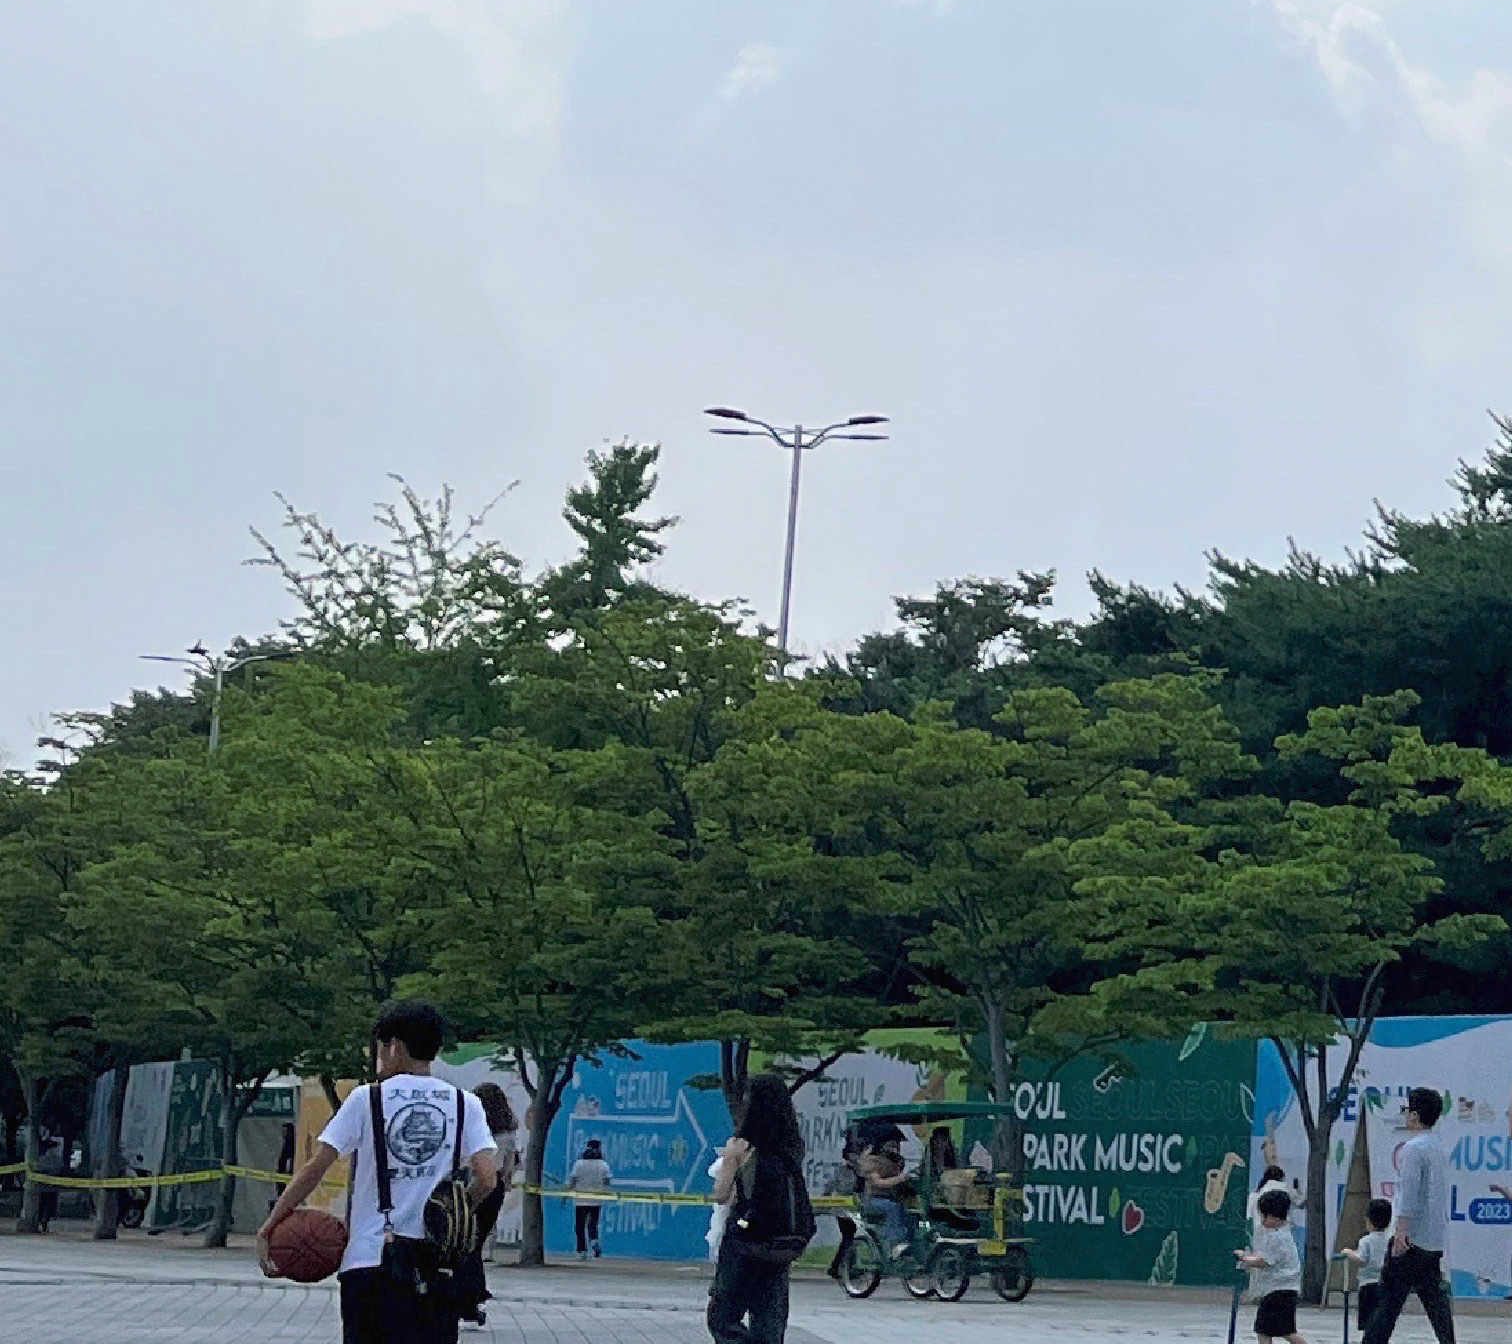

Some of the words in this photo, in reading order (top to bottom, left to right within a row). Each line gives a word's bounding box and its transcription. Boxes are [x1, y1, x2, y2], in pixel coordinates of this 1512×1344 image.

[817, 1076, 869, 1108] SEOUL
[1008, 1081, 1067, 1120] OUL
[1022, 1132, 1088, 1171] PARK
[1093, 1132, 1184, 1173] MUSIC
[1021, 1184, 1105, 1225] STIVAL
[1476, 1202, 1511, 1219] 2023
